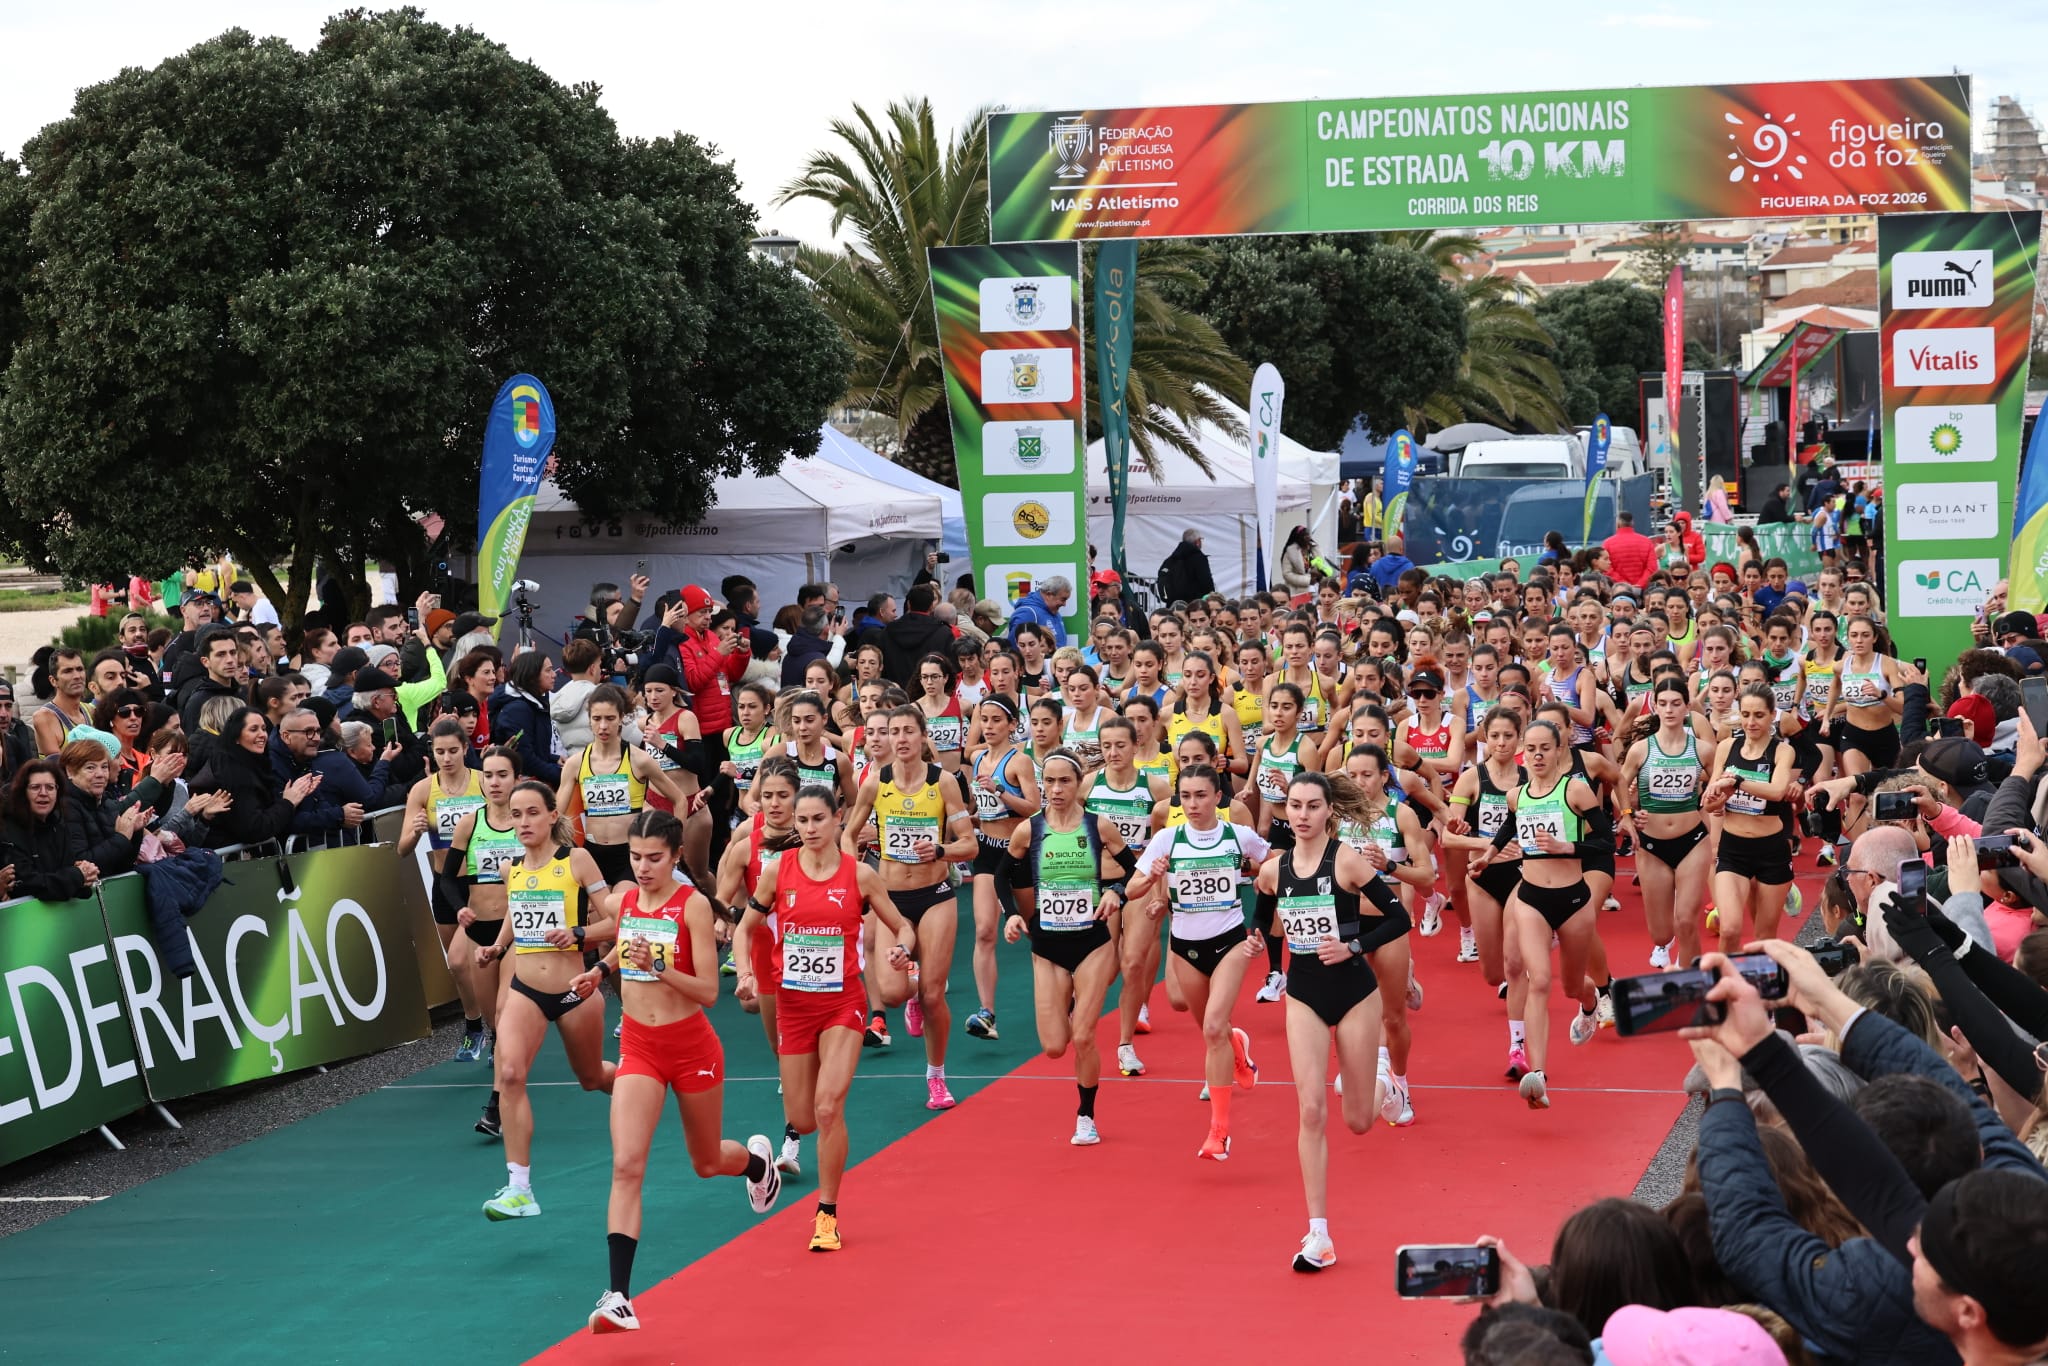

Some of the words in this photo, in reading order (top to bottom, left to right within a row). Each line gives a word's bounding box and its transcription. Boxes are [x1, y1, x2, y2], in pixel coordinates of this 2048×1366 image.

[1317, 105, 1492, 140] CAMPEONATOS
[1501, 100, 1630, 133] NACIONAIS
[1099, 126, 1173, 140] FEDERAÇÃO
[1829, 117, 1944, 147] figueira
[1099, 143, 1173, 156] PORTUGUESA
[1829, 144, 1866, 168] da
[1875, 143, 1919, 167] foz
[1097, 158, 1174, 172] ATLETISMO
[1325, 157, 1355, 188] DE
[1363, 153, 1469, 186] ESTRADA
[1478, 140, 1535, 181] 10
[1543, 140, 1625, 179] KM
[1050, 197, 1093, 212] MAIS
[1097, 195, 1179, 211] Atletismo
[1408, 197, 1468, 216] CORRIDA
[1473, 195, 1501, 214] DOS
[1507, 194, 1538, 213] REIS
[1760, 195, 1830, 209] FIGUEIRA
[1833, 194, 1855, 206] DA
[1859, 193, 1888, 205] FOZ
[1892, 192, 1927, 204] 2026
[1074, 219, 1151, 228] www.fpatletismo.pt
[1908, 278, 1966, 297] PUMA
[1908, 345, 1979, 371] Vitalis
[1259, 391, 1274, 427] CA
[1949, 411, 1963, 421] bp
[513, 454, 538, 464] Turismo
[513, 464, 534, 473] Centro
[513, 473, 538, 485] Portugal
[1906, 504, 1988, 514] RADIANT
[502, 509, 521, 554] NUNCA
[510, 502, 530, 555] DEMAIS
[493, 555, 506, 589] AQUI
[1946, 570, 1982, 592] CA
[1653, 774, 1693, 788] 2252
[587, 789, 626, 804] 2432
[1731, 799, 1750, 807] MEIRA
[986, 837, 1010, 848] NIKE
[1180, 877, 1231, 896] 2380
[518, 891, 527, 899] CA
[1284, 898, 1295, 906] CA
[1042, 899, 1088, 915] 2078
[513, 911, 559, 929] 2374
[1283, 917, 1332, 935] 2438
[798, 925, 842, 935] navarra
[793, 935, 805, 943] CA
[788, 954, 836, 974] 2365
